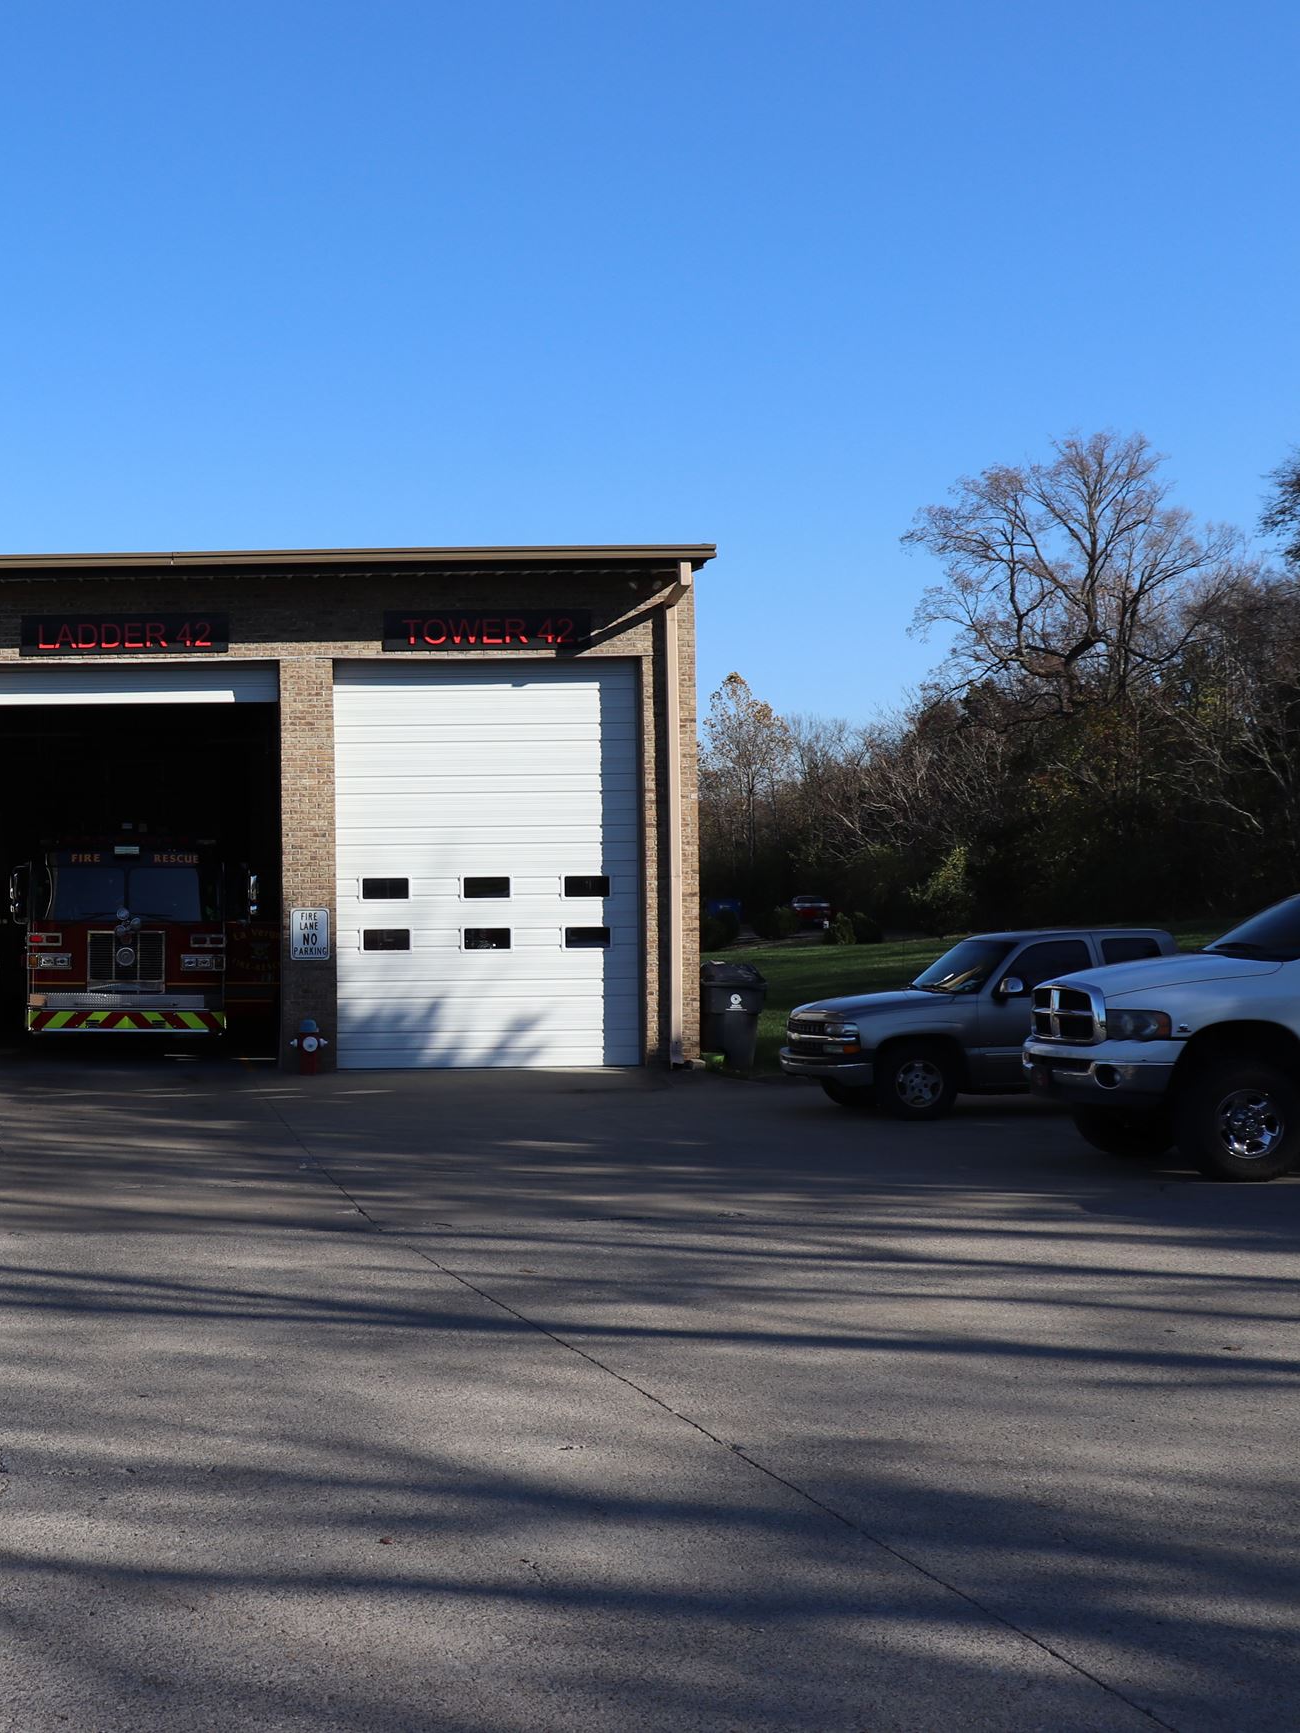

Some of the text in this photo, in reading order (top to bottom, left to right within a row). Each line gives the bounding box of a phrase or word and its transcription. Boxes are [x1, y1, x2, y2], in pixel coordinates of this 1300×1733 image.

[38, 622, 213, 649] LADDER 42
[402, 618, 574, 644] TOWER 42
[71, 853, 200, 864] FIRE RESCUE
[300, 912, 319, 921] FIRE
[300, 922, 319, 931] LANE
[302, 933, 318, 946] NO
[294, 947, 327, 956] PARKING
